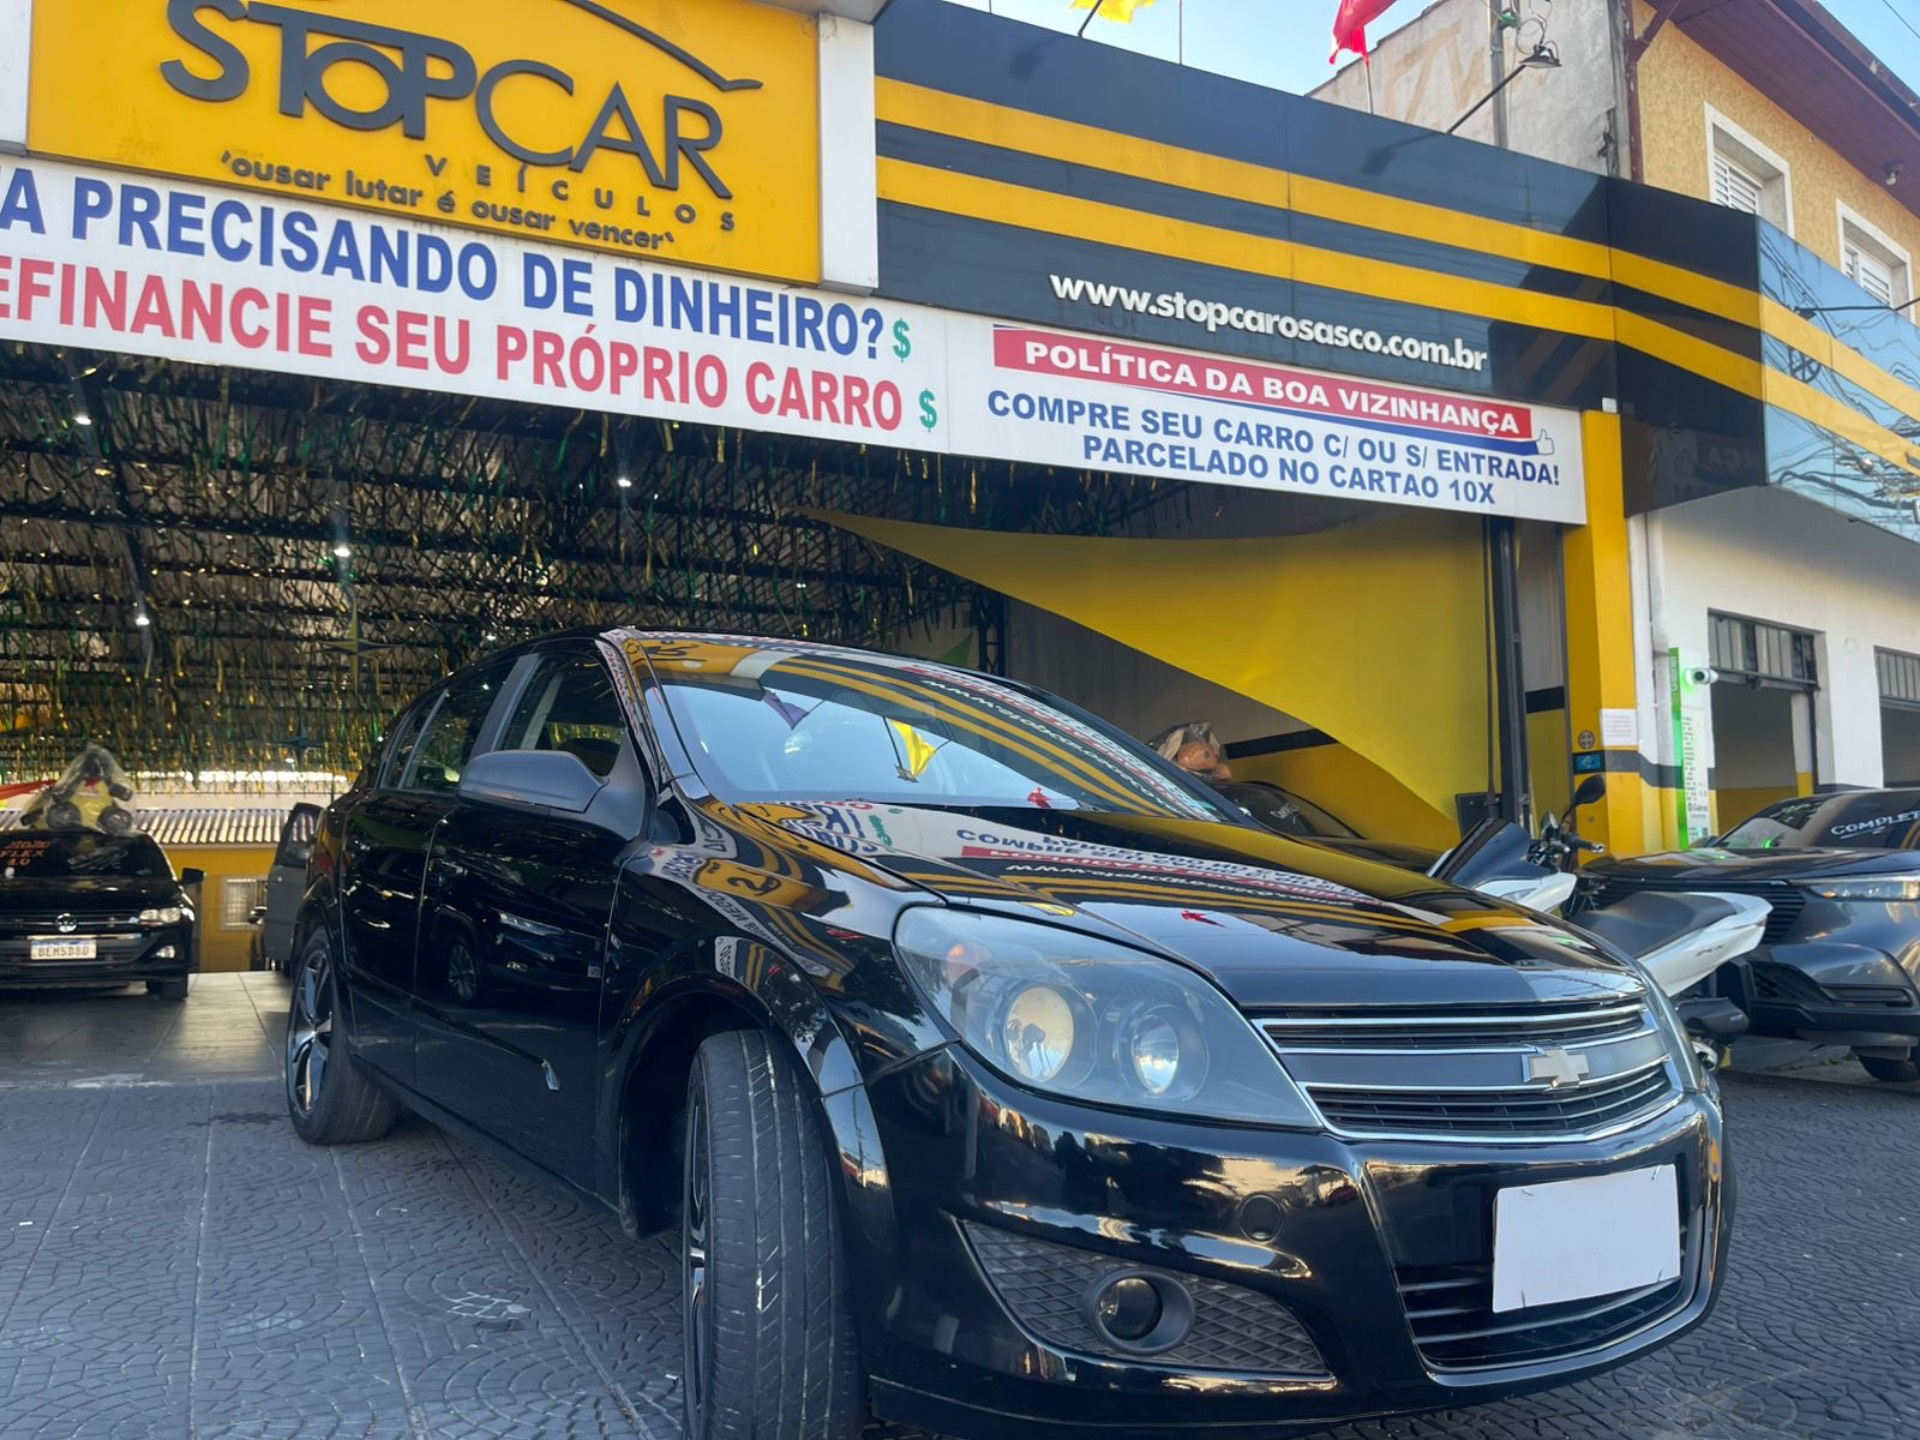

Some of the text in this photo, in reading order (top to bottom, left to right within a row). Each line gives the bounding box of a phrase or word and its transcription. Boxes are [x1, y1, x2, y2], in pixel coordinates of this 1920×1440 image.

[160, 0, 733, 200] STOPCAR
[346, 169, 423, 207] lutar
[437, 190, 456, 214] é
[471, 199, 556, 230] ousar
[425, 154, 736, 231] VEÍCULOS
[72, 176, 497, 301] PRECISANDO
[523, 252, 593, 317] DE
[614, 267, 884, 360] DINHEIRO?
[355, 305, 470, 375] SEU
[497, 323, 728, 408] PRÓPRIO
[745, 361, 902, 431] CARRO
[1049, 273, 1488, 371] www.stopcarosasco.com.br
[1025, 341, 1520, 435] POLÍTICA DA BOA VIZINHANÇA
[988, 390, 1560, 485] COMPRE SEU CARRO C/ OU S/ ENTRADA!
[1083, 435, 1496, 504] PARCELADO NO CARTAO 10X
